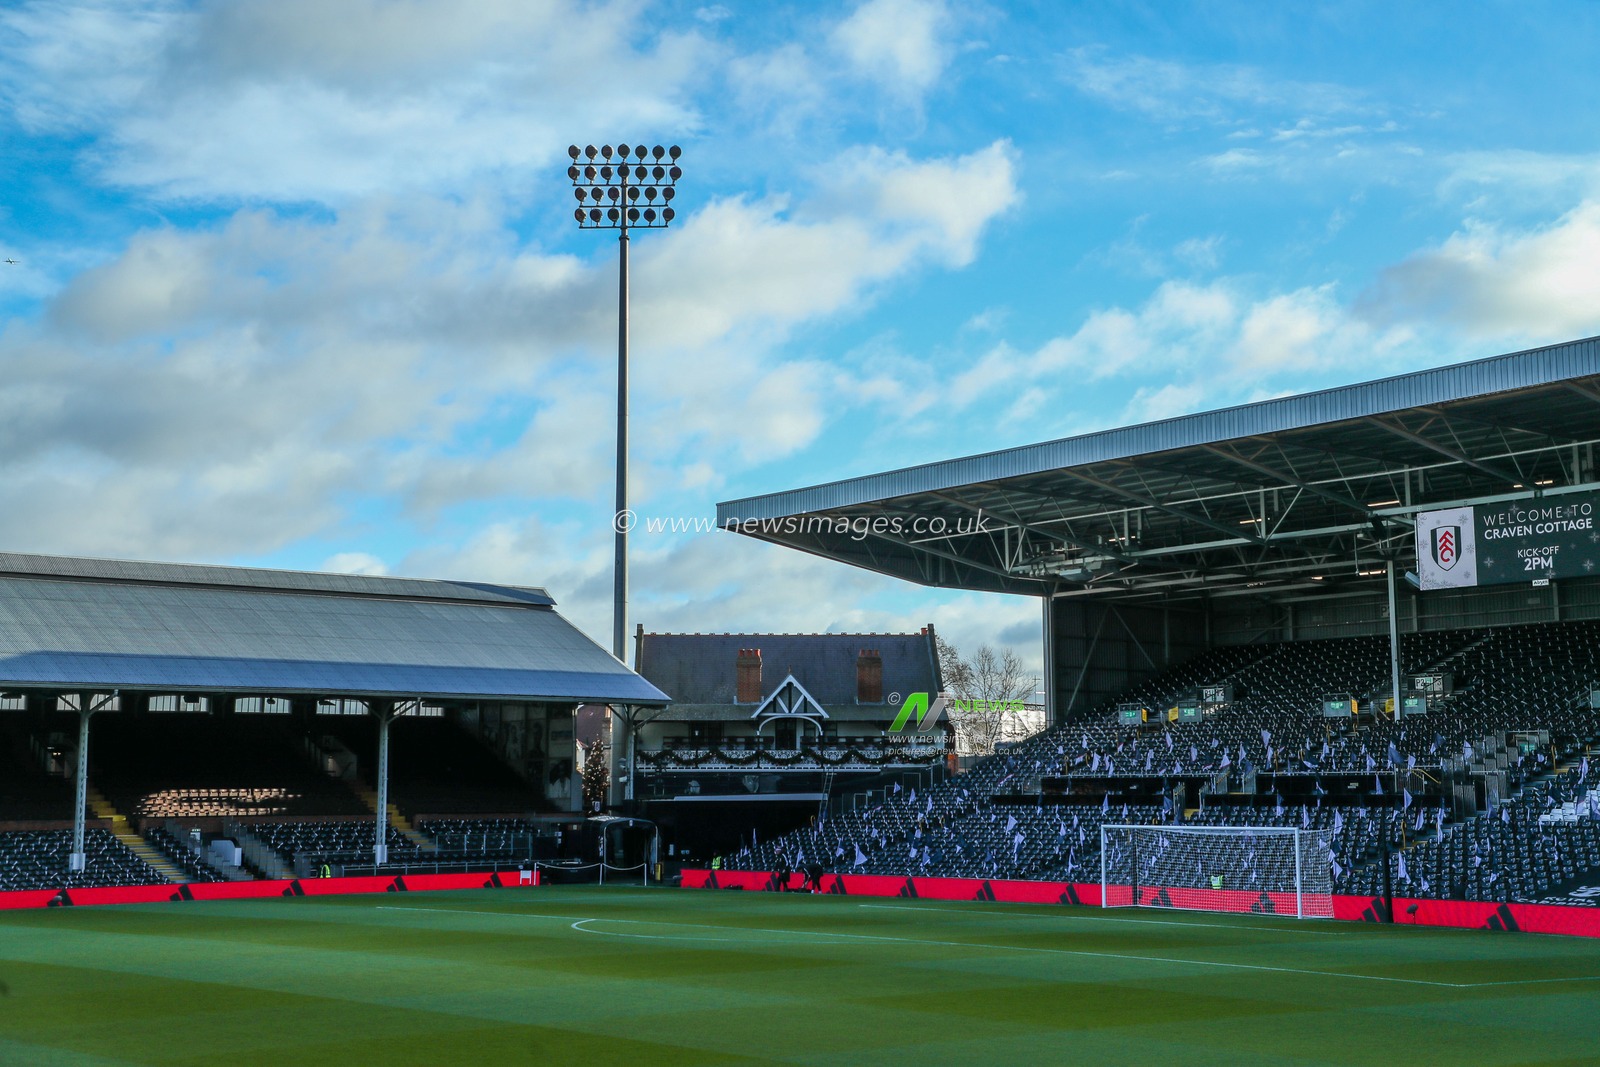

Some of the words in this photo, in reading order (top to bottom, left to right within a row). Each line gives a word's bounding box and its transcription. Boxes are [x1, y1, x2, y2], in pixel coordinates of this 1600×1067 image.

[1483, 506, 1563, 527] WELCOME
[1571, 503, 1592, 516] TO
[1484, 525, 1533, 540] CRAVEN
[1535, 518, 1593, 534] COTTAGE
[1517, 546, 1559, 558] KICK-OFF
[1524, 556, 1553, 571] 2PM
